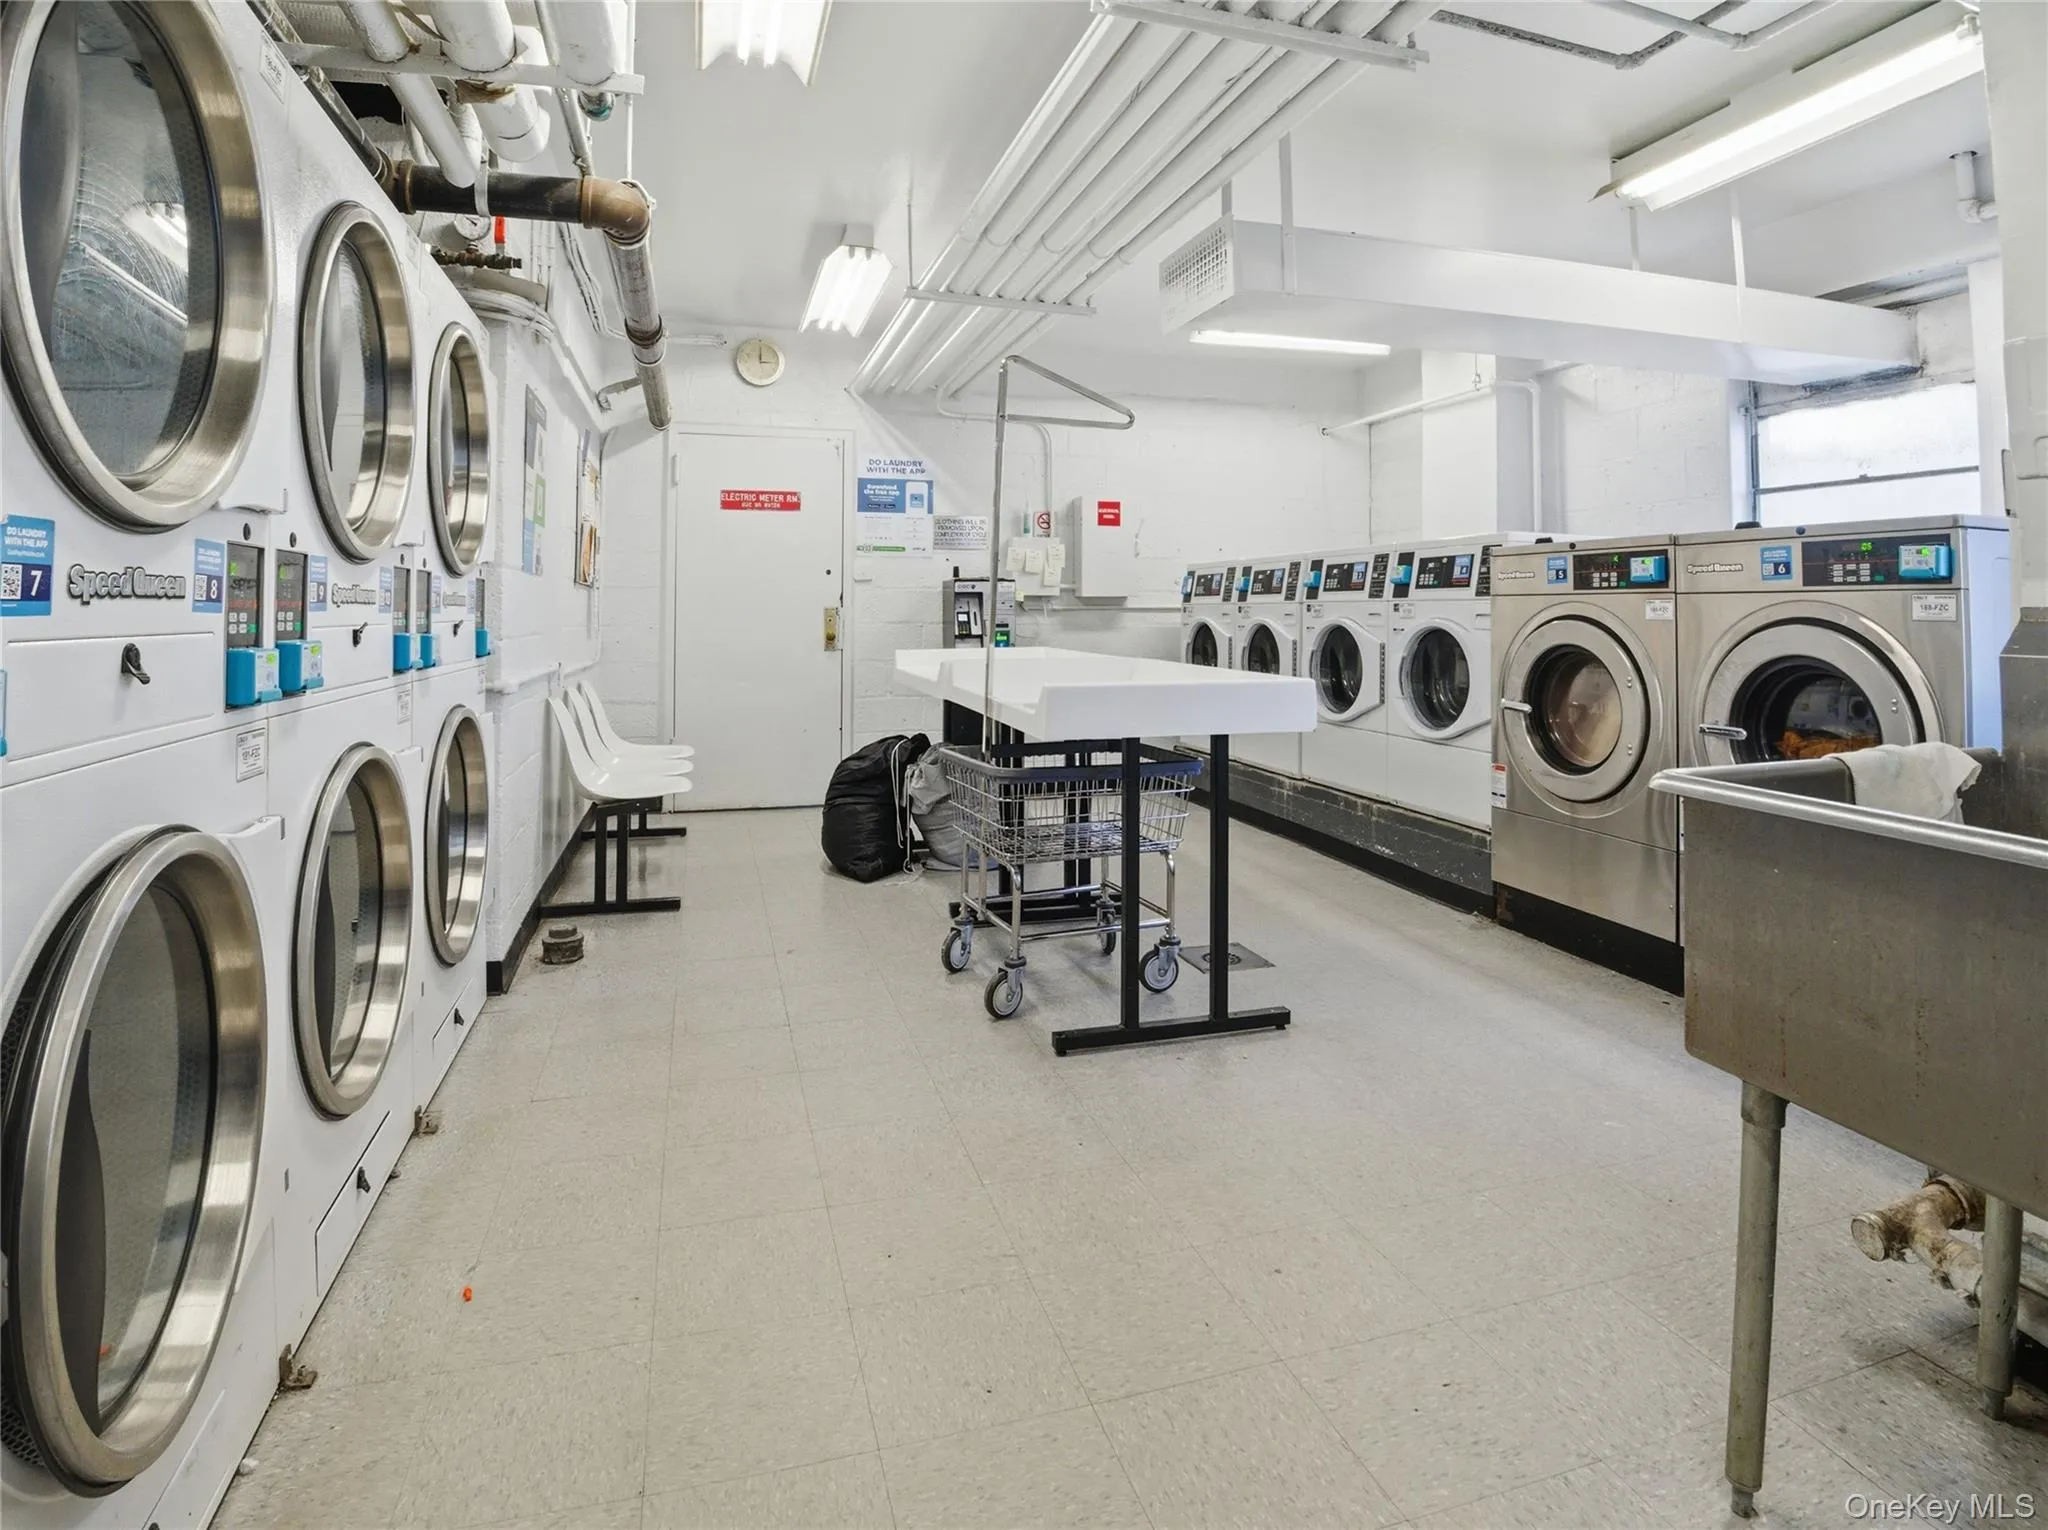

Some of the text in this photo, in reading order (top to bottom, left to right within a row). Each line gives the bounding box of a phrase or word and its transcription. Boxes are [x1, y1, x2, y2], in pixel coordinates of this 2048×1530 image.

[869, 458, 923, 467] DO LAUNDRY
[866, 466, 888, 474] WITH
[891, 467, 906, 475] THE
[721, 493, 757, 502] ELECTRIC
[759, 494, 784, 503] METER
[6, 527, 47, 539] DO LAUNDRY
[4, 535, 48, 549] WITH THE APP
[1687, 562, 1744, 575] Speed Queen
[1778, 563, 1785, 574] 6
[29, 570, 42, 597] 7
[69, 563, 187, 606] Speed Queen
[210, 579, 218, 599] 8
[318, 584, 324, 600] 9
